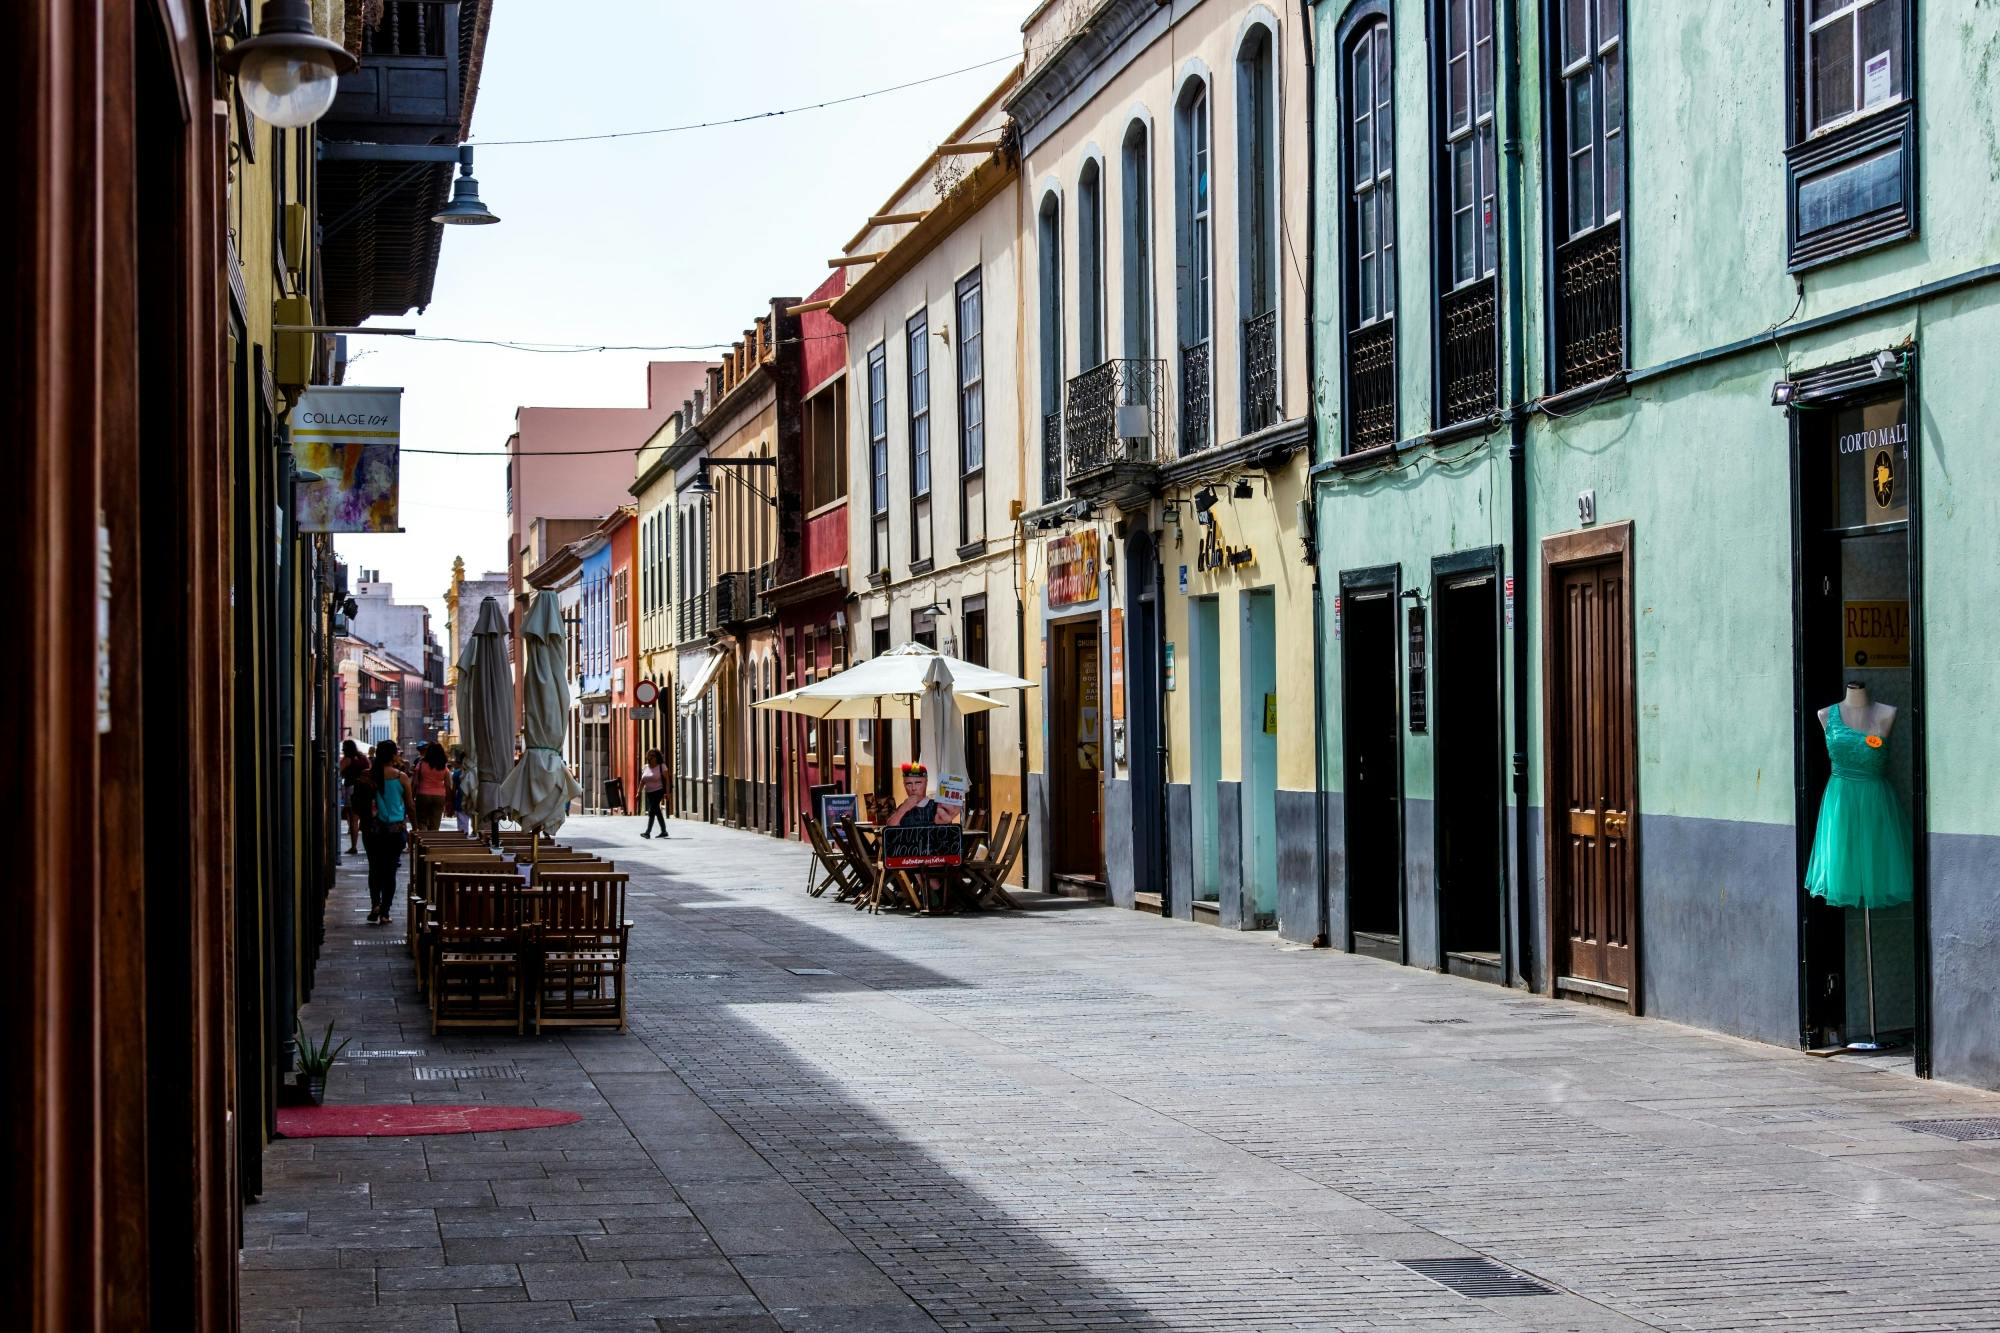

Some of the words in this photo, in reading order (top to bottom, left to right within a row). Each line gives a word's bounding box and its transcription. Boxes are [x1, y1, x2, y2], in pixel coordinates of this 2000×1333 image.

[303, 412, 366, 425] COLLAGE
[367, 415, 389, 426] 104
[1840, 429, 1877, 454] CORTO
[1846, 607, 1909, 645] REBAJA
